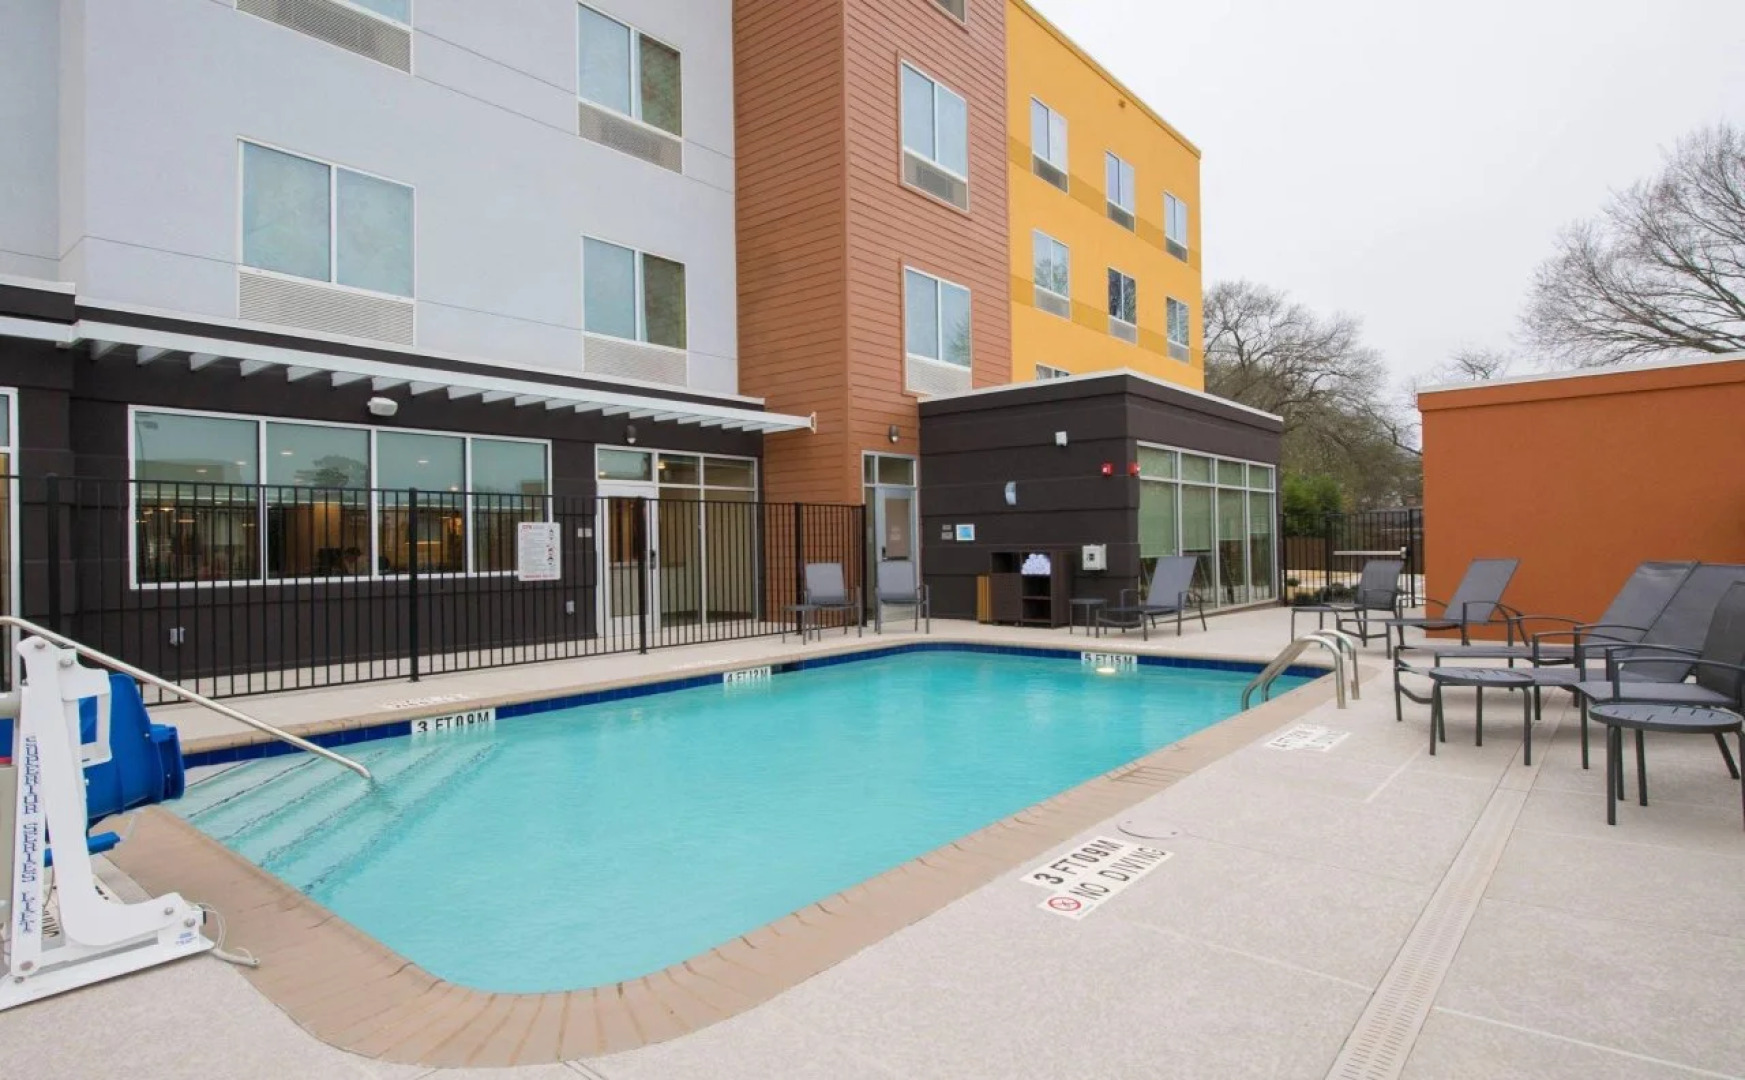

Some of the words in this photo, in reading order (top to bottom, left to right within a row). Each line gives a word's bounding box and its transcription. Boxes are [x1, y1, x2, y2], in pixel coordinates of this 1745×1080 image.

[417, 720, 428, 733] 3
[20, 823, 36, 884] SERIES
[1069, 882, 1111, 901] NO
[1097, 847, 1166, 882] DIVING
[1033, 872, 1064, 885] 3
[18, 891, 35, 933] LIFT
